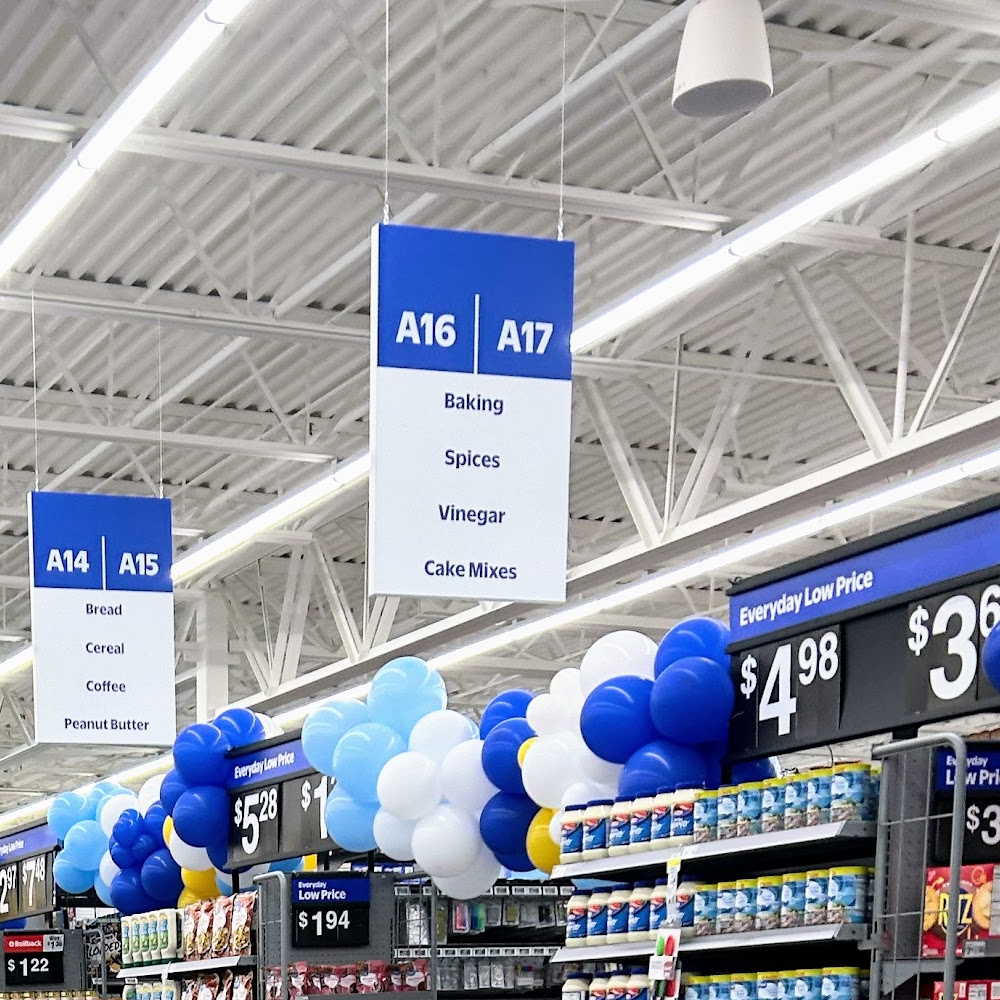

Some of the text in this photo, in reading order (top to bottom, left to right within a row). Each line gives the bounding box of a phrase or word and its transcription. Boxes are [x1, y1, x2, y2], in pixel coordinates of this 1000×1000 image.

[395, 310, 554, 354] A16 A17
[444, 392, 504, 415] Baking
[444, 449, 500, 469] Spices
[438, 504, 506, 526] Vinegar
[46, 548, 159, 576] A14 A15
[424, 560, 517, 580] Cake Mixes
[739, 570, 873, 627] Everyday Low Price
[85, 603, 122, 616] Bread
[85, 642, 125, 655] Cereal
[86, 680, 126, 693] Coffee
[64, 717, 149, 731] Peanut Butter
[234, 751, 295, 779] Everyday Low Price
[946, 769, 977, 785] Lw
[298, 881, 327, 890] Everyday
[298, 889, 346, 900] Low Price
[15, 940, 42, 948] Rollback
